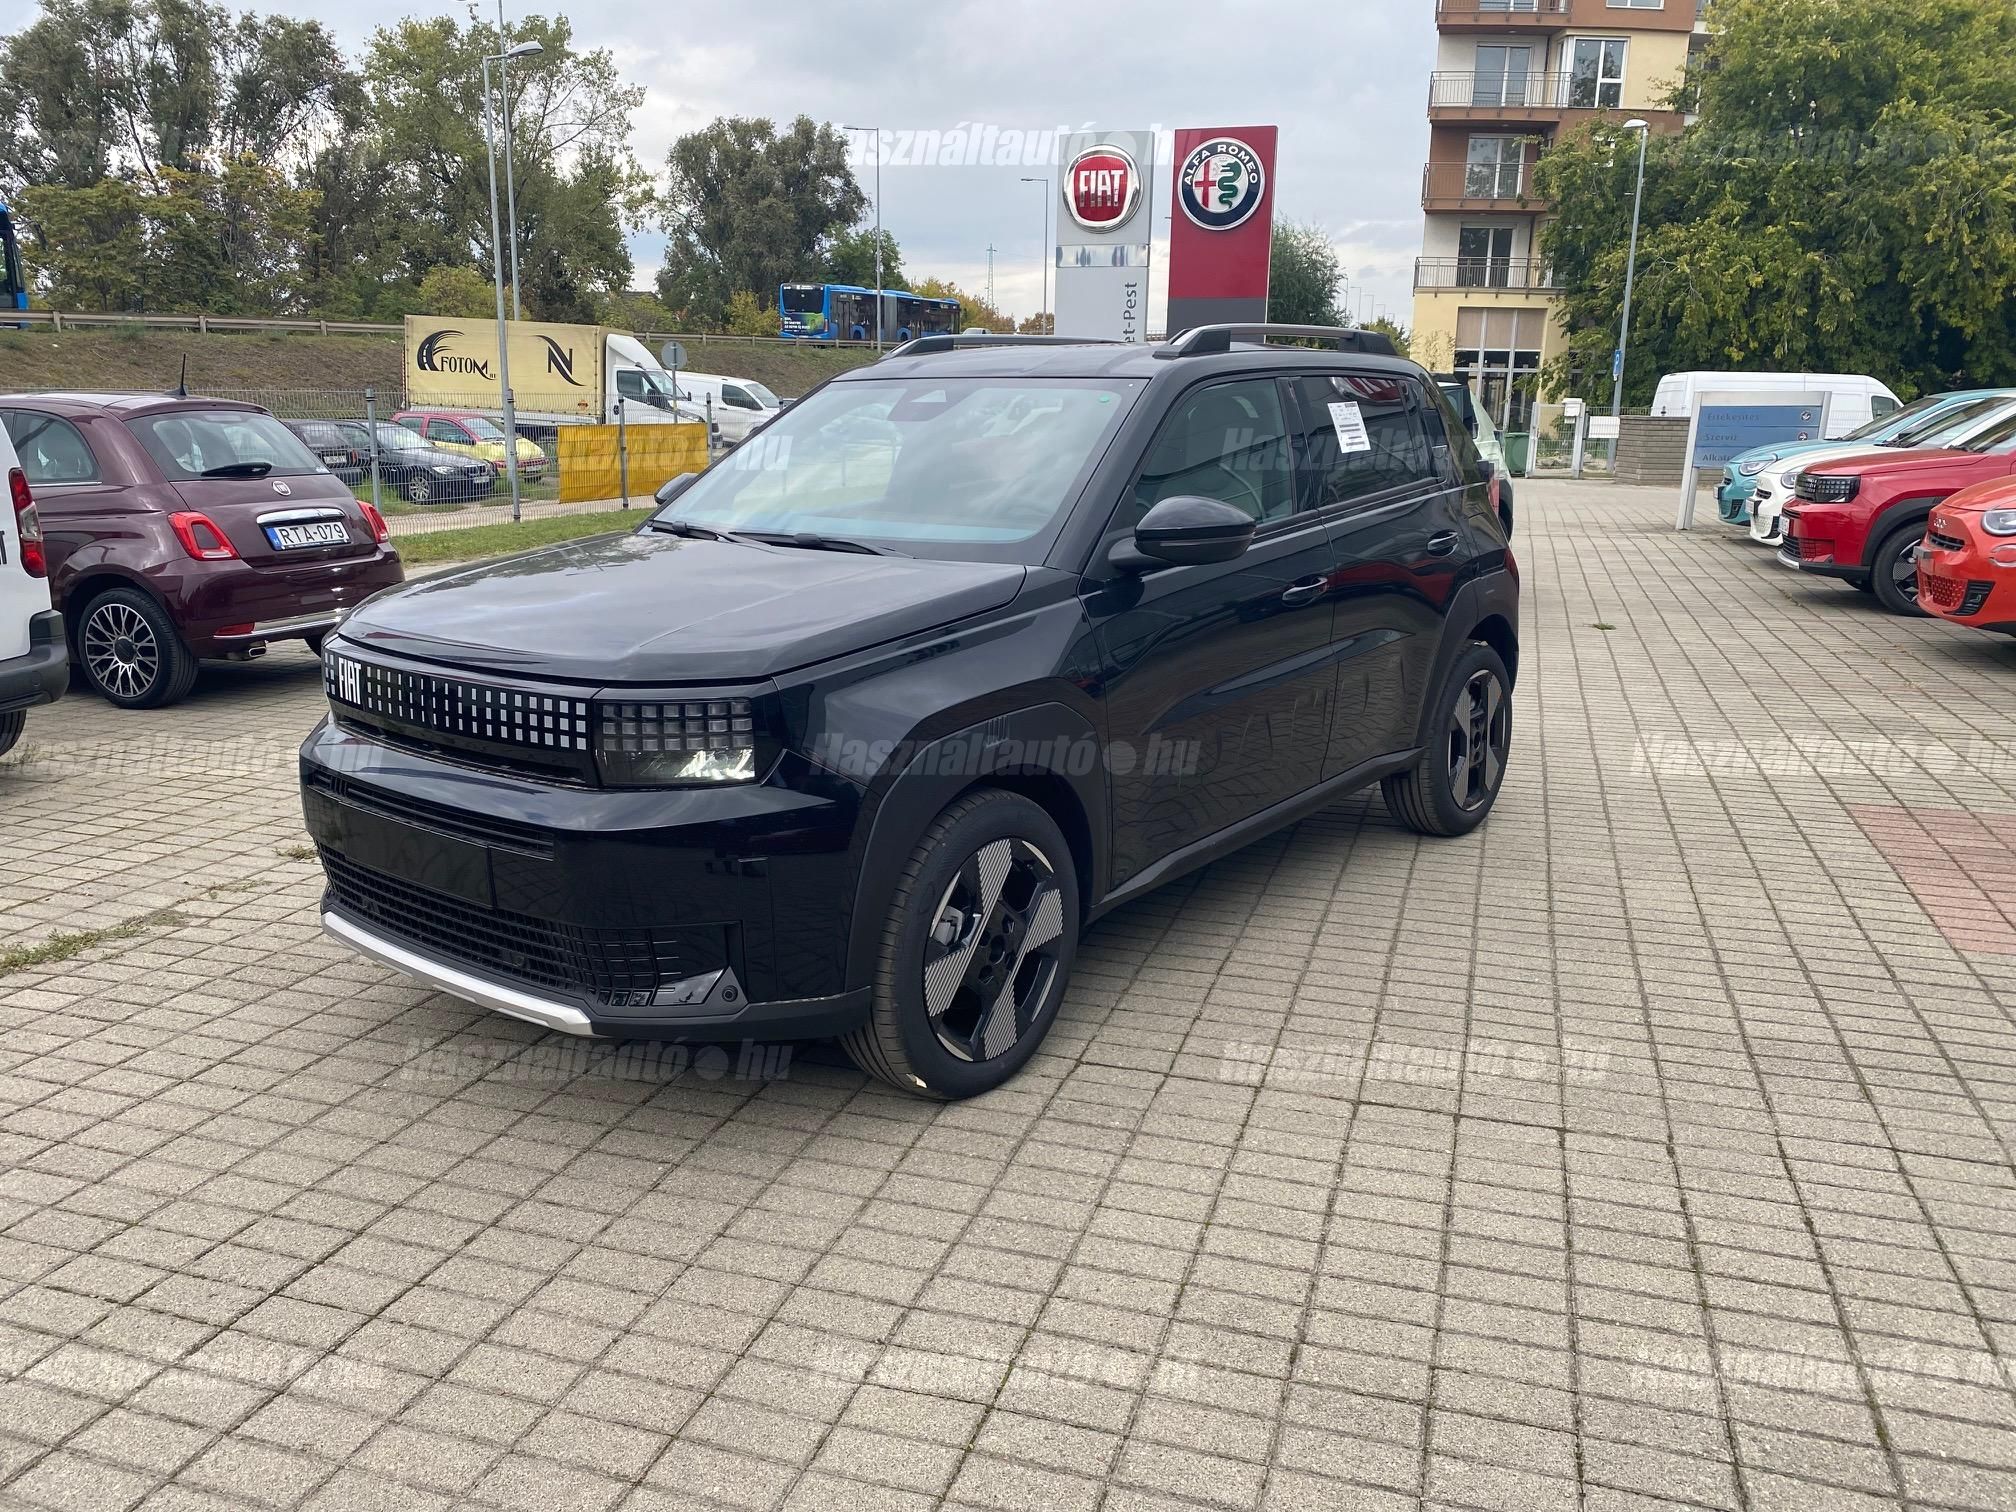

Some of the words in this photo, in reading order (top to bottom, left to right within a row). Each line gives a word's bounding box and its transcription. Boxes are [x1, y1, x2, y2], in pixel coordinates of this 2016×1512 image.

[1184, 150, 1211, 186] ALFA
[1217, 144, 1258, 184] ROMEO
[1079, 169, 1124, 208] FIAT
[279, 523, 345, 545] RTA-079
[338, 657, 361, 705] FIAT
